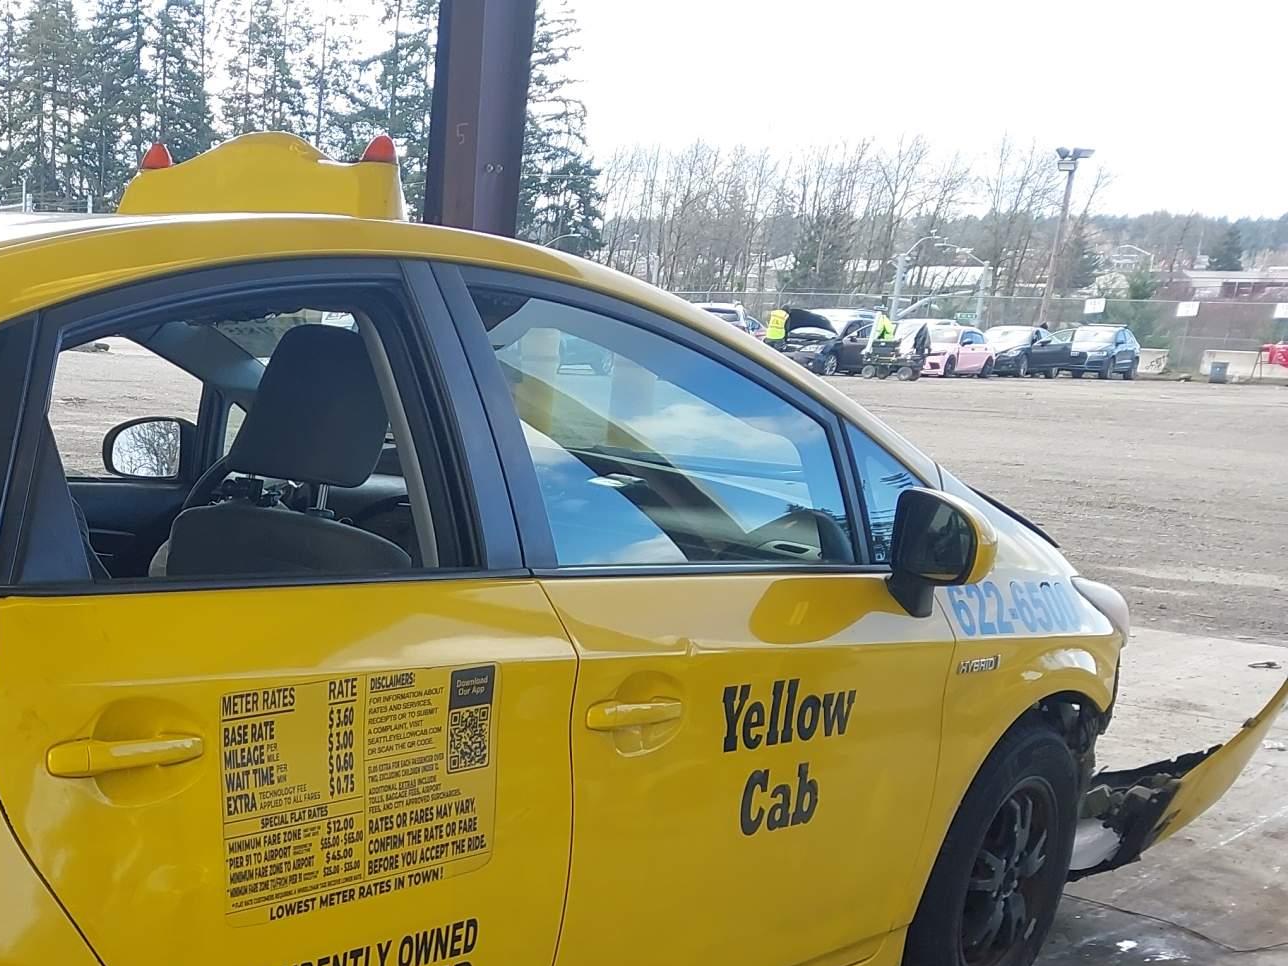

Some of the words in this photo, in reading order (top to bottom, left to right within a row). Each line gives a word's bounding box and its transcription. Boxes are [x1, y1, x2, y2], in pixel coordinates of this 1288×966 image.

[946, 581, 1081, 637] 622-6500
[959, 656, 997, 674] HYBRID
[328, 678, 358, 700] RATE
[370, 672, 415, 690] DISCLAIMERS:
[456, 675, 488, 688] Download
[458, 687, 470, 696] Our
[472, 685, 485, 695] App
[223, 692, 258, 716] METER
[263, 687, 295, 710] RATES
[383, 690, 422, 704] INFORMATION
[424, 687, 444, 698] ABOUT
[389, 703, 401, 712] AND
[398, 712, 407, 721] OR
[409, 710, 415, 719] TO
[722, 678, 857, 753] Yellow
[224, 724, 248, 747] BASE
[251, 721, 274, 743] RATE
[224, 745, 264, 770] MILEAGE
[267, 743, 278, 752] PER
[378, 743, 394, 754] SCAN
[395, 742, 405, 751] THE
[277, 764, 287, 773] PER
[225, 770, 250, 793] WAIT
[253, 766, 274, 789] TIME
[259, 786, 295, 800] TECHNOLOGY
[297, 784, 307, 794] FEE
[260, 798, 282, 810] APPLIED
[284, 797, 291, 806] TO
[293, 795, 302, 804] ALL
[304, 792, 320, 802] FARES
[740, 762, 819, 837] Cab
[227, 792, 257, 816] EXTRA
[261, 813, 288, 829] SPECIAL
[291, 810, 305, 823] FLAT
[308, 806, 328, 820] RATES
[326, 817, 354, 835] $12.00
[369, 815, 393, 835] RATES
[396, 812, 407, 829] OR
[409, 807, 433, 826] FARES
[436, 803, 453, 821] MAY
[228, 836, 261, 854] MINIMUM
[264, 833, 280, 847] FARE
[283, 828, 302, 844] ZONE
[368, 832, 404, 855] CONFIRM
[407, 828, 421, 846] THE
[424, 824, 443, 843] RATE
[446, 821, 456, 838] OR
[458, 816, 477, 835] FARE
[245, 853, 252, 866] 91
[253, 851, 262, 865] TO
[264, 846, 291, 863] AIRPORT
[368, 853, 398, 875] BEFORE
[401, 849, 417, 868] YOU
[419, 842, 449, 864] ACCEPT
[451, 839, 465, 857] THE
[255, 865, 268, 879] FARE
[285, 860, 291, 873] TO
[269, 898, 317, 921] LOWEST
[319, 888, 355, 909] METER
[359, 880, 391, 899] RATES
[394, 876, 405, 891] IN
[408, 867, 444, 888] TOWN!
